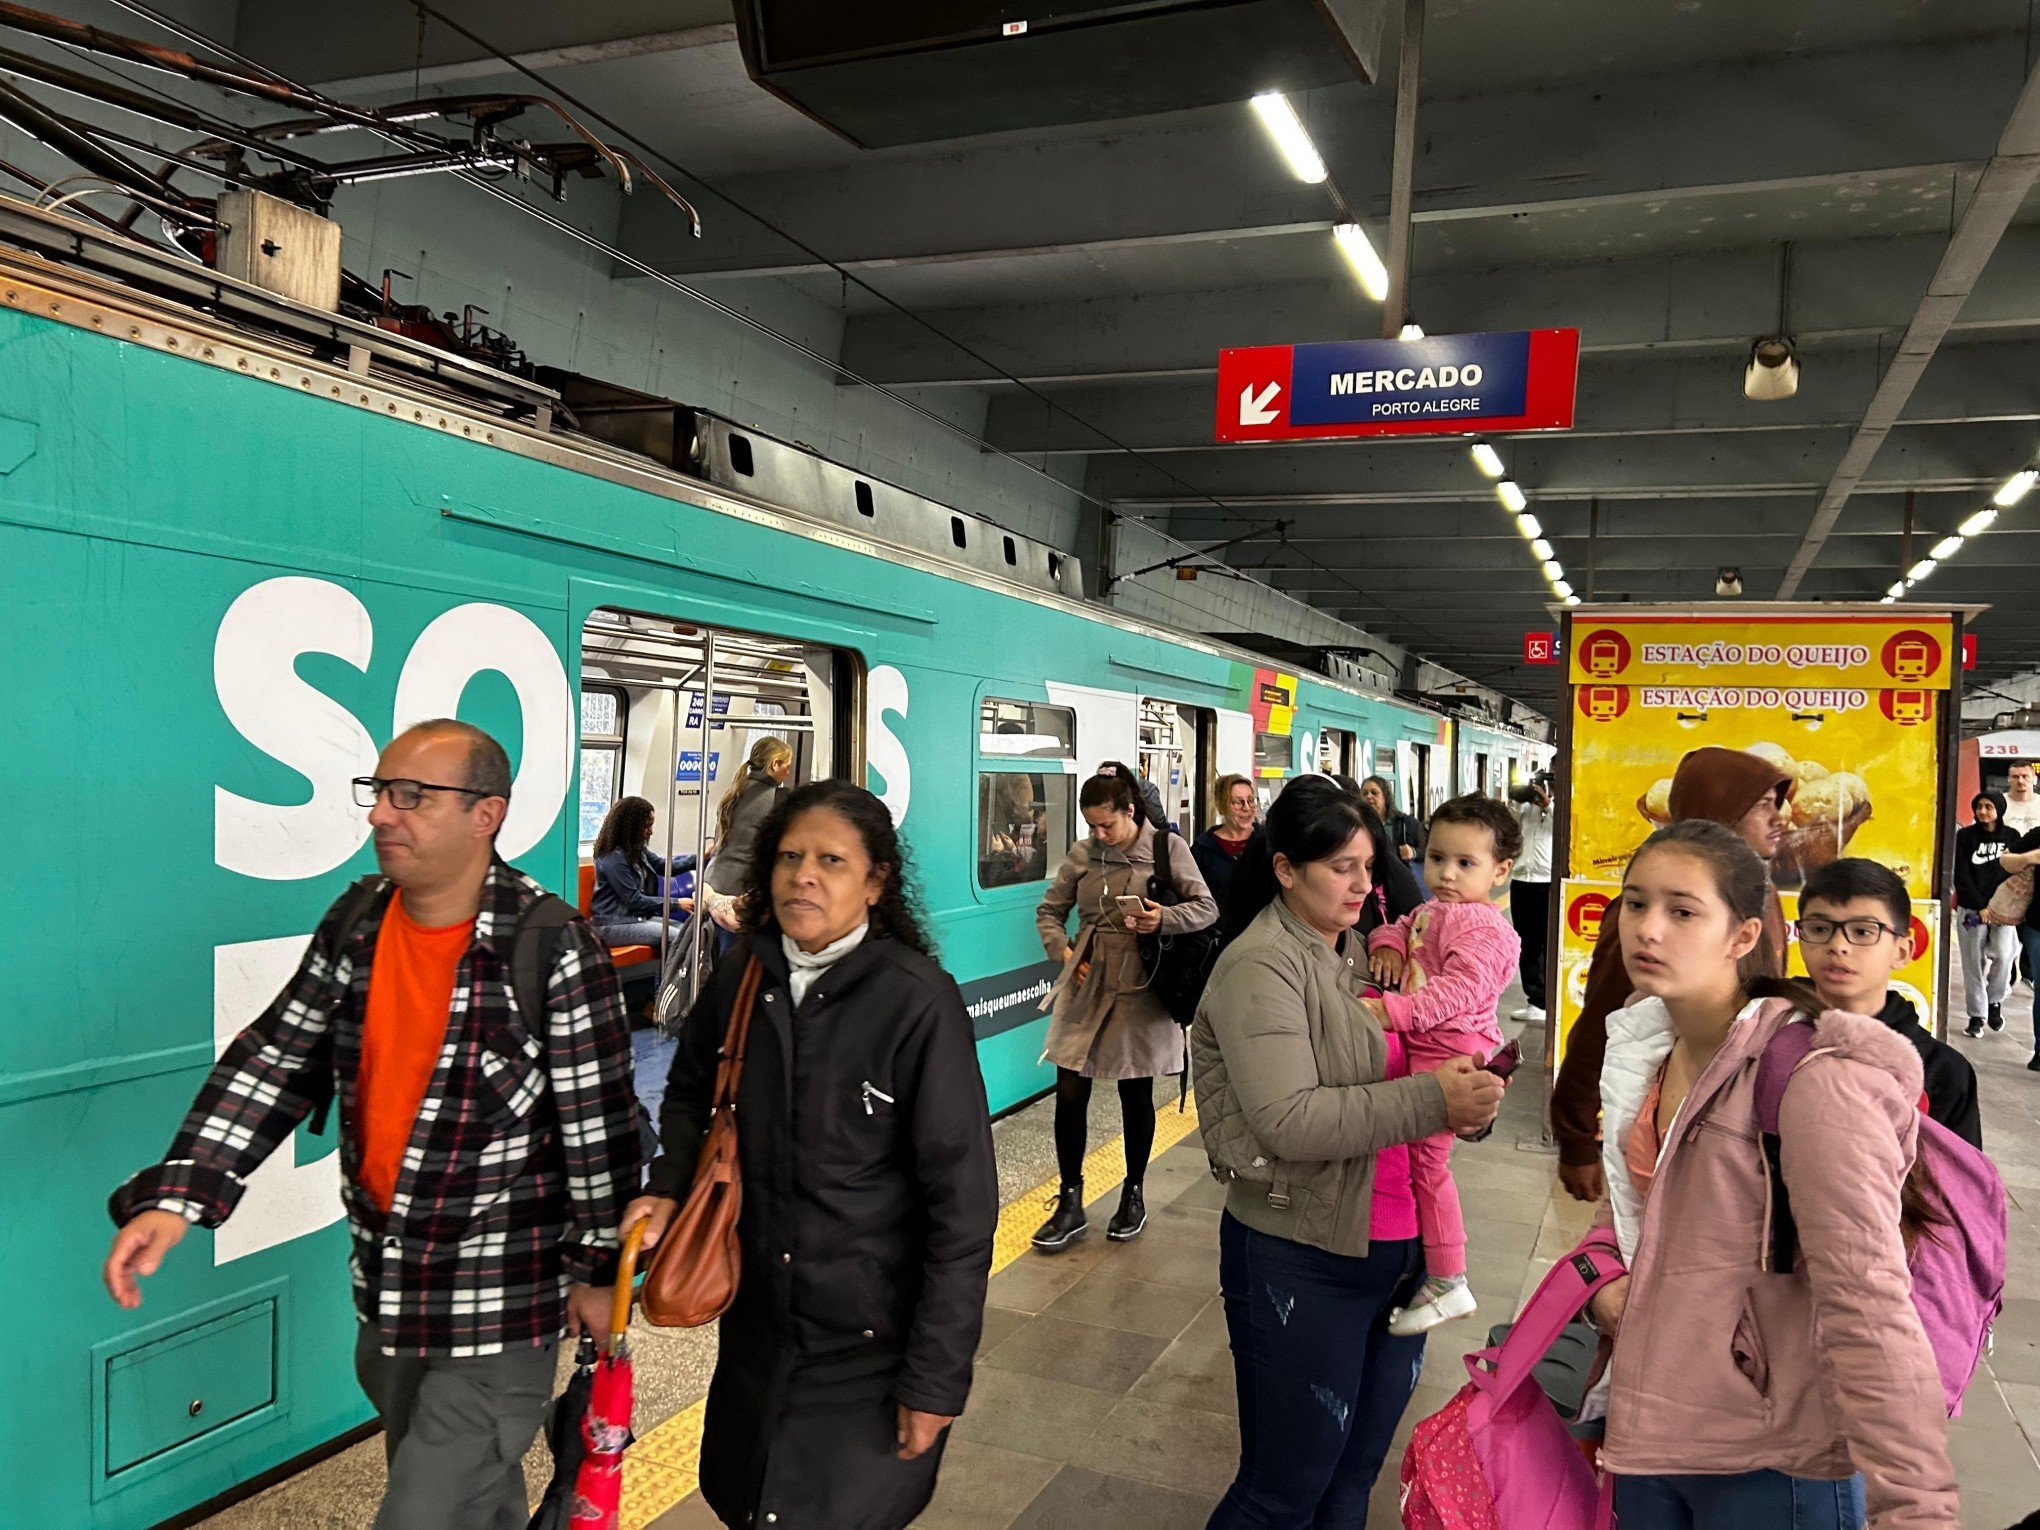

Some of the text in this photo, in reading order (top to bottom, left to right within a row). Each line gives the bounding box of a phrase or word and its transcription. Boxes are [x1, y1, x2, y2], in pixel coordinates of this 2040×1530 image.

[1330, 364, 1483, 396] MERCADO
[1372, 398, 1480, 416] PORTO ALEGRE
[1642, 642, 1868, 668] ESTAÇÃO DO QUEIJO
[1641, 687, 1866, 711] ESTAÇÃO DO QUEIJO
[688, 716, 699, 726] RA
[1984, 745, 2019, 754] 238
